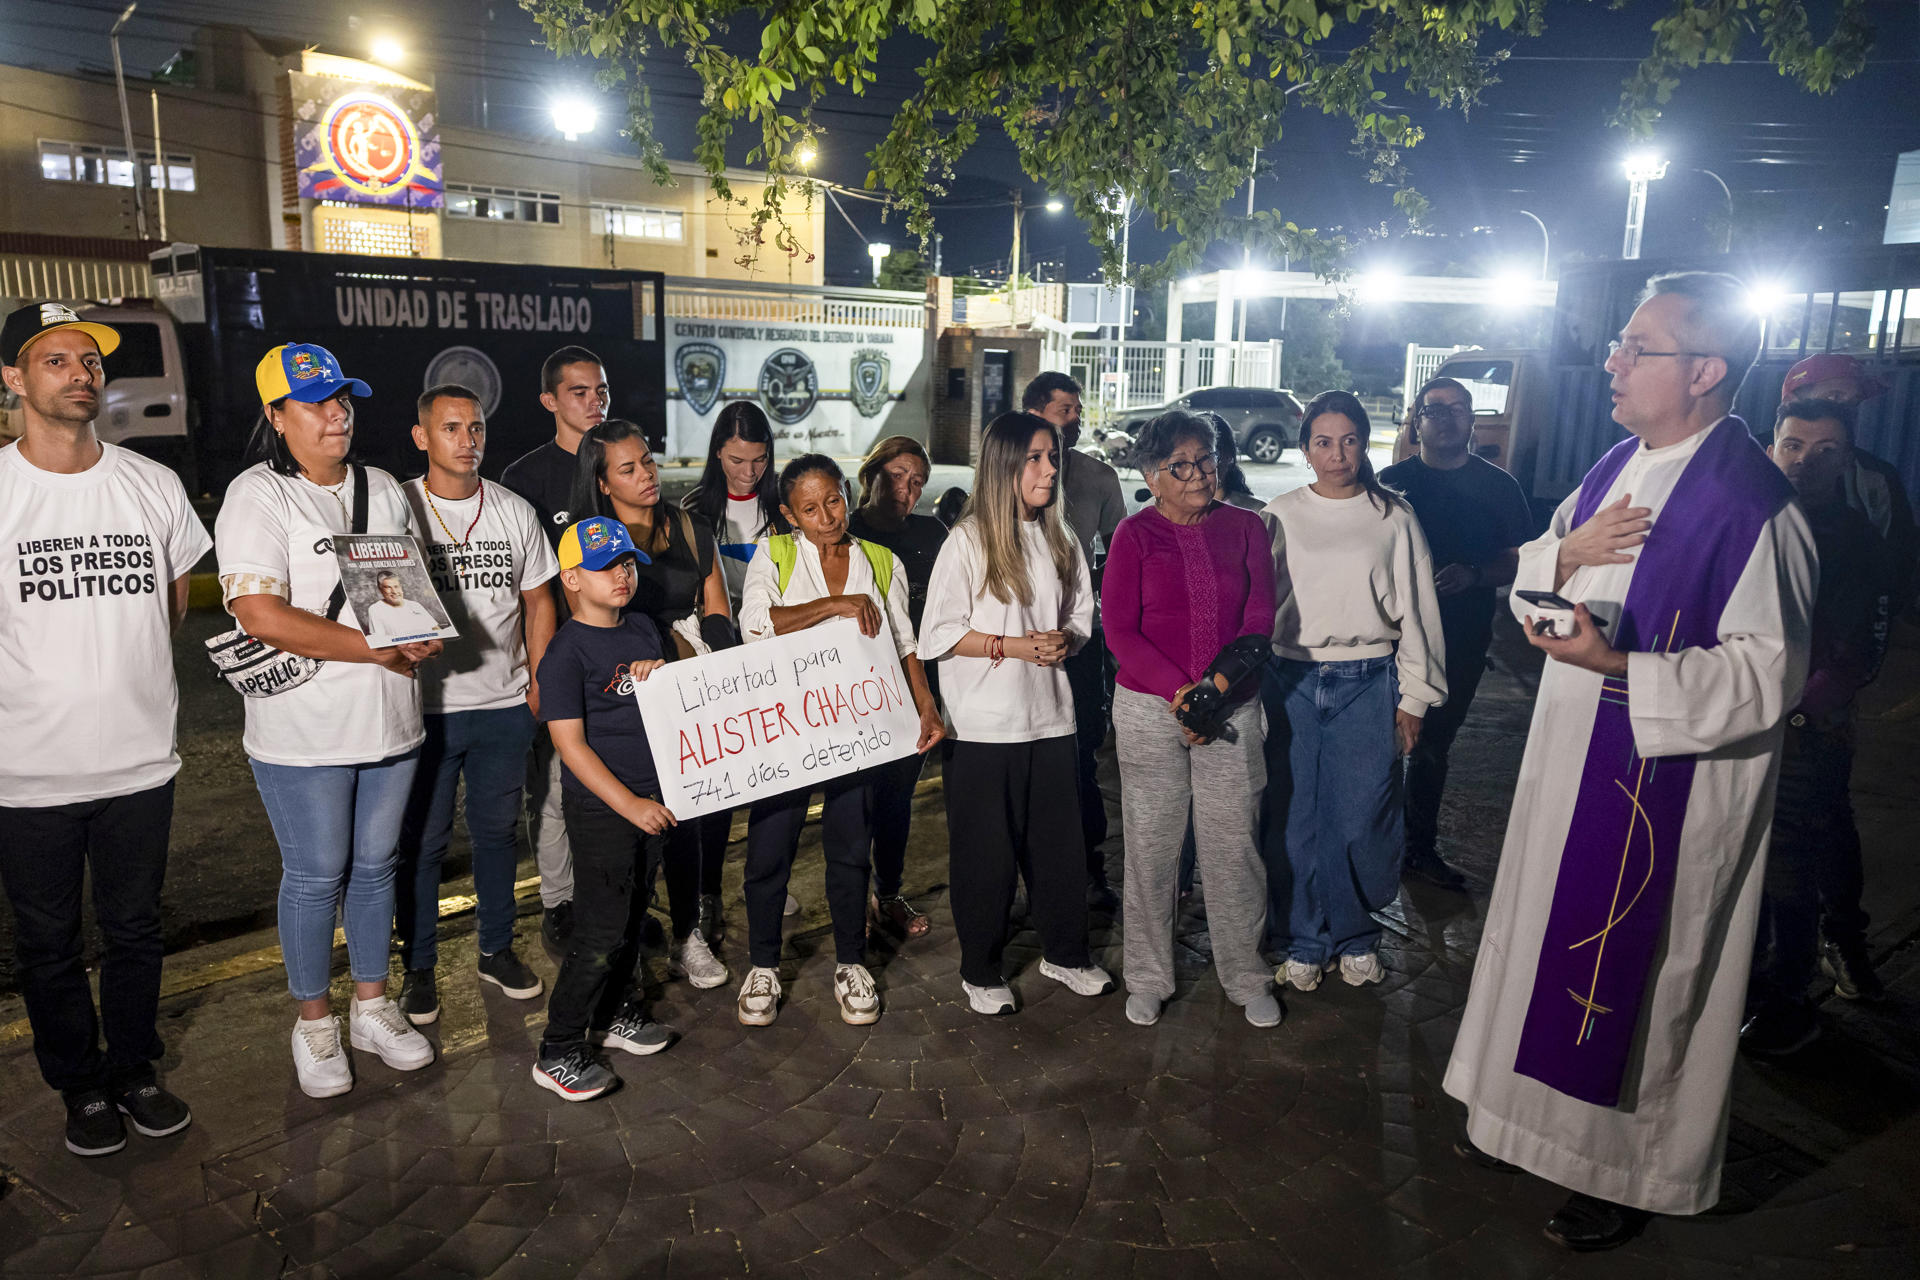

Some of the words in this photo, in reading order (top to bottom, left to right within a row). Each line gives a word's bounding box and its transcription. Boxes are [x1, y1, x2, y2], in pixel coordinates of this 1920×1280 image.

[336, 286, 429, 328] UNIDAD
[436, 291, 468, 329] DE
[475, 291, 592, 333] TRASLADO
[675, 323, 716, 338] CENTRO
[718, 326, 756, 340] CONTROL
[18, 536, 84, 555] LIBEREN
[89, 535, 99, 548] A
[103, 534, 151, 547] TODOS
[349, 542, 404, 559] LIBERTAD
[465, 542, 473, 552] A
[476, 541, 511, 551] TODOS
[19, 556, 63, 576] LOS
[71, 551, 153, 571] PRESOS
[430, 557, 447, 573] OS
[452, 554, 512, 570] PRESOS
[19, 572, 155, 603] POLÍTICOS
[435, 571, 512, 593] OLÍTICOS
[237, 656, 301, 695] APEHLIC
[675, 660, 777, 713] Libertad
[793, 647, 842, 686] para
[679, 702, 801, 775] ALISTER
[803, 665, 903, 729] CHACÓN
[682, 771, 741, 805] 741
[747, 762, 790, 788] días
[802, 724, 891, 771] detenido
